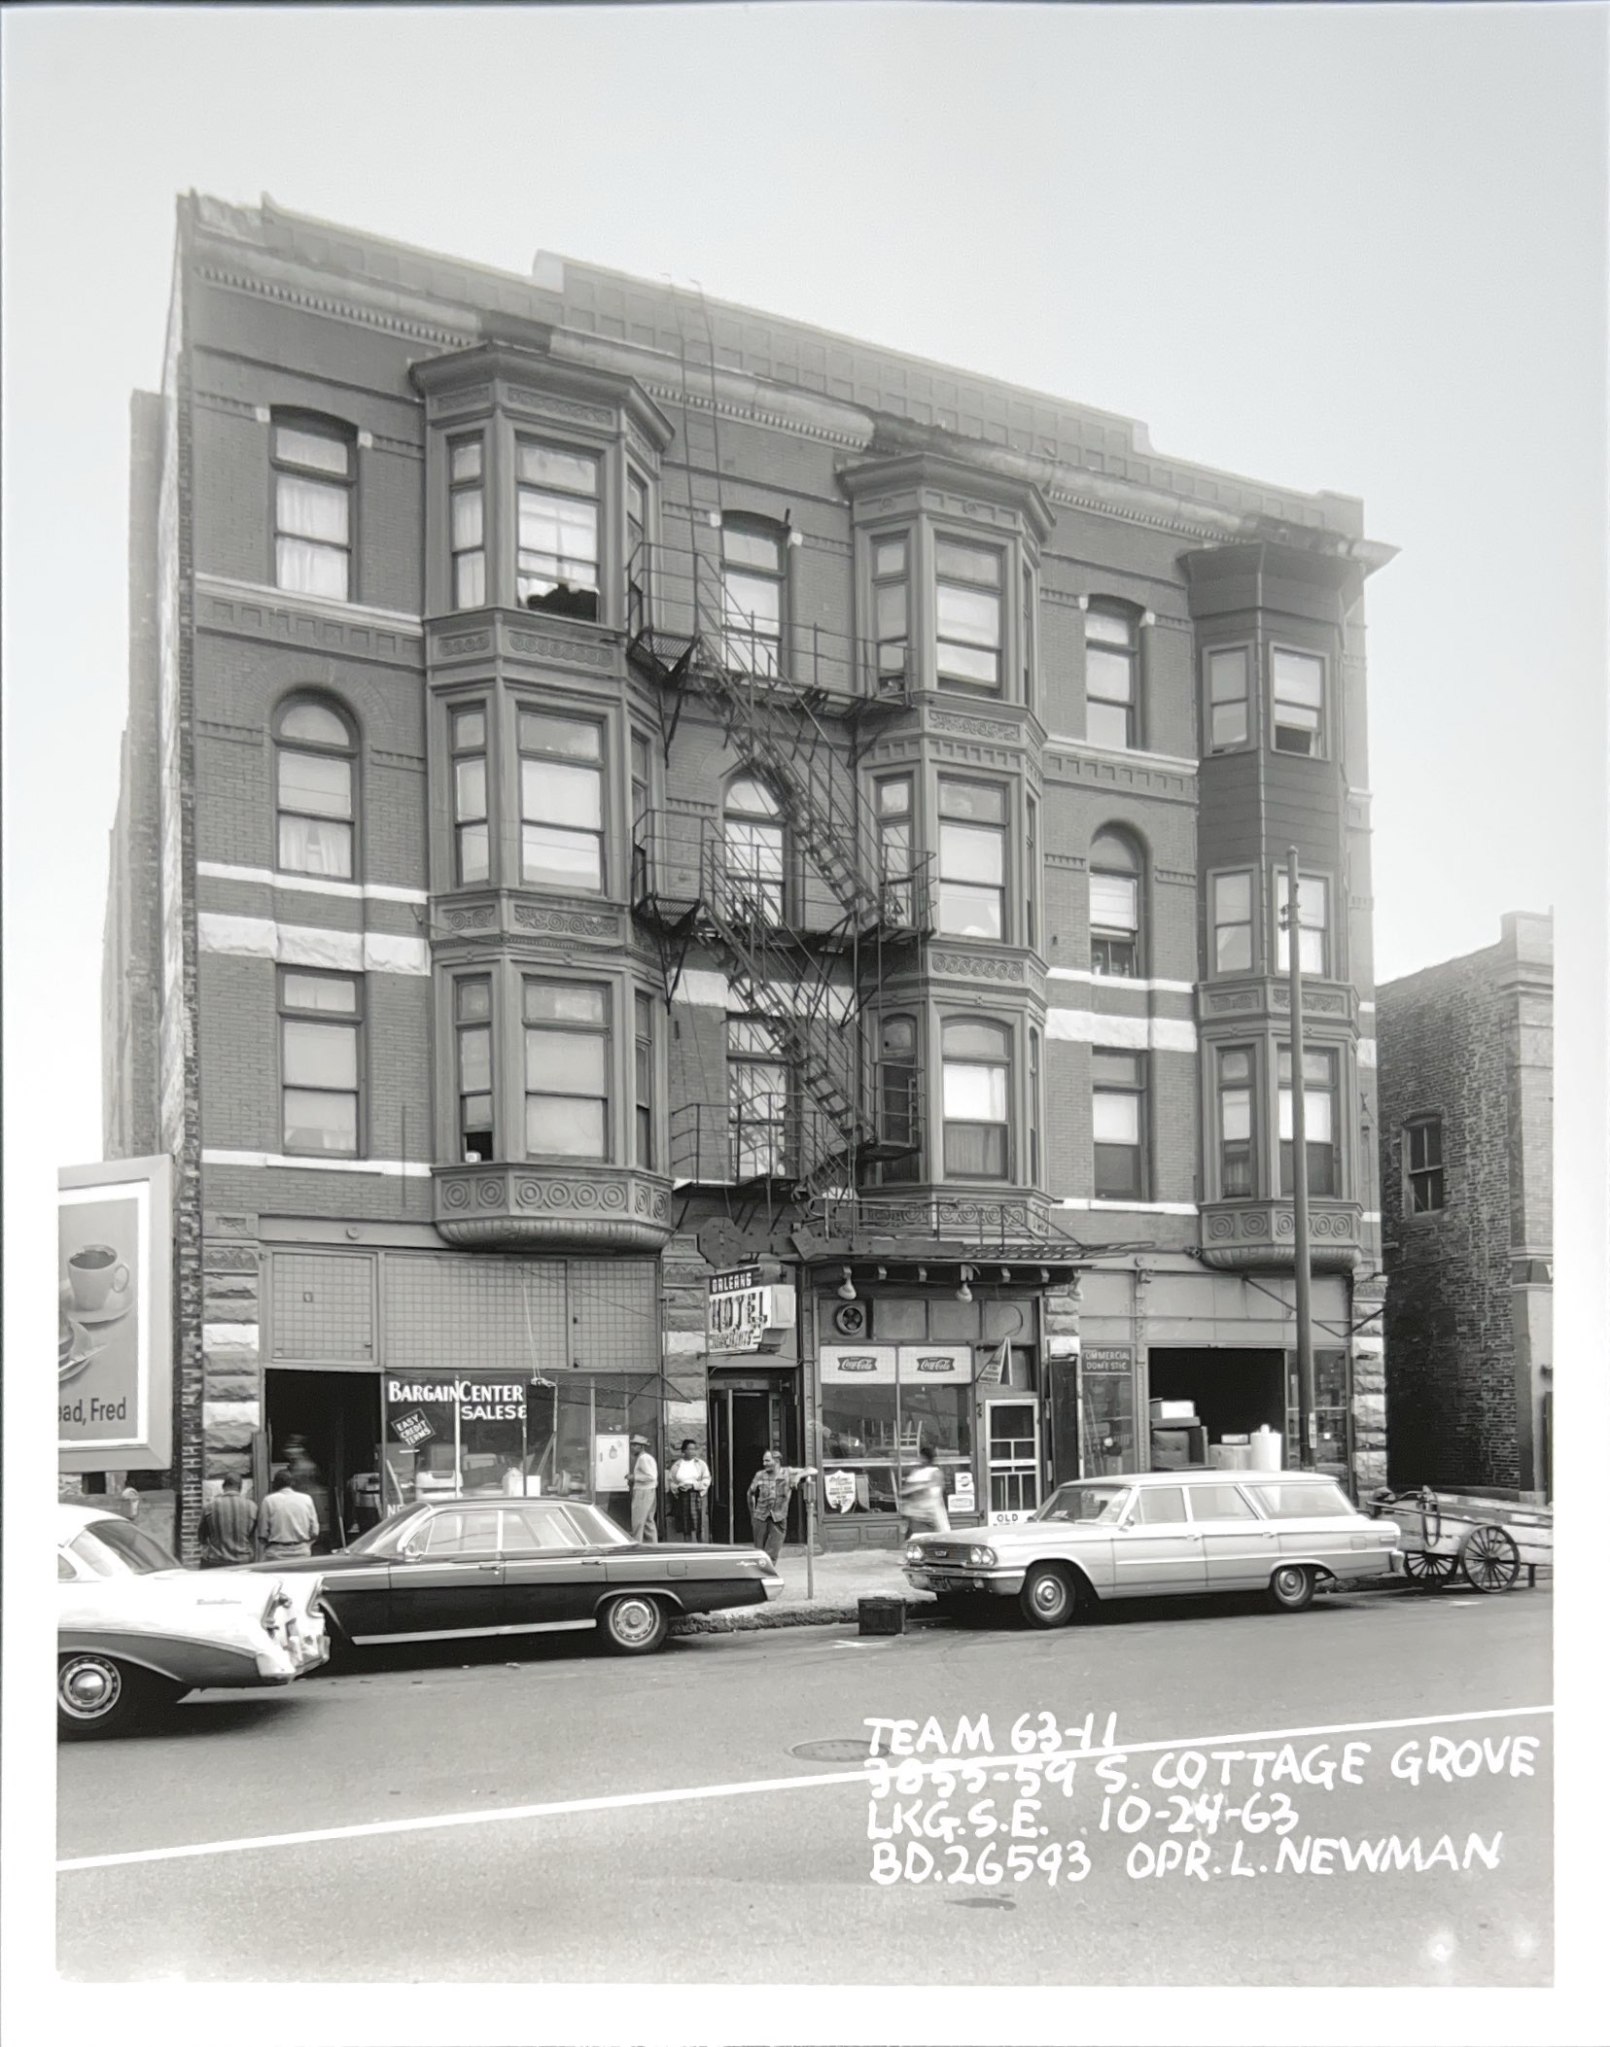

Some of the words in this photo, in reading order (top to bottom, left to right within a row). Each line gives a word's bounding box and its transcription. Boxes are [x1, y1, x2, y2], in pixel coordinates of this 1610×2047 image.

[711, 1291, 768, 1333] HOTEL
[459, 1380, 524, 1402] CENTER
[90, 1396, 126, 1421] Fred
[396, 1413, 419, 1432] EASY
[996, 1513, 1018, 1523] OLD
